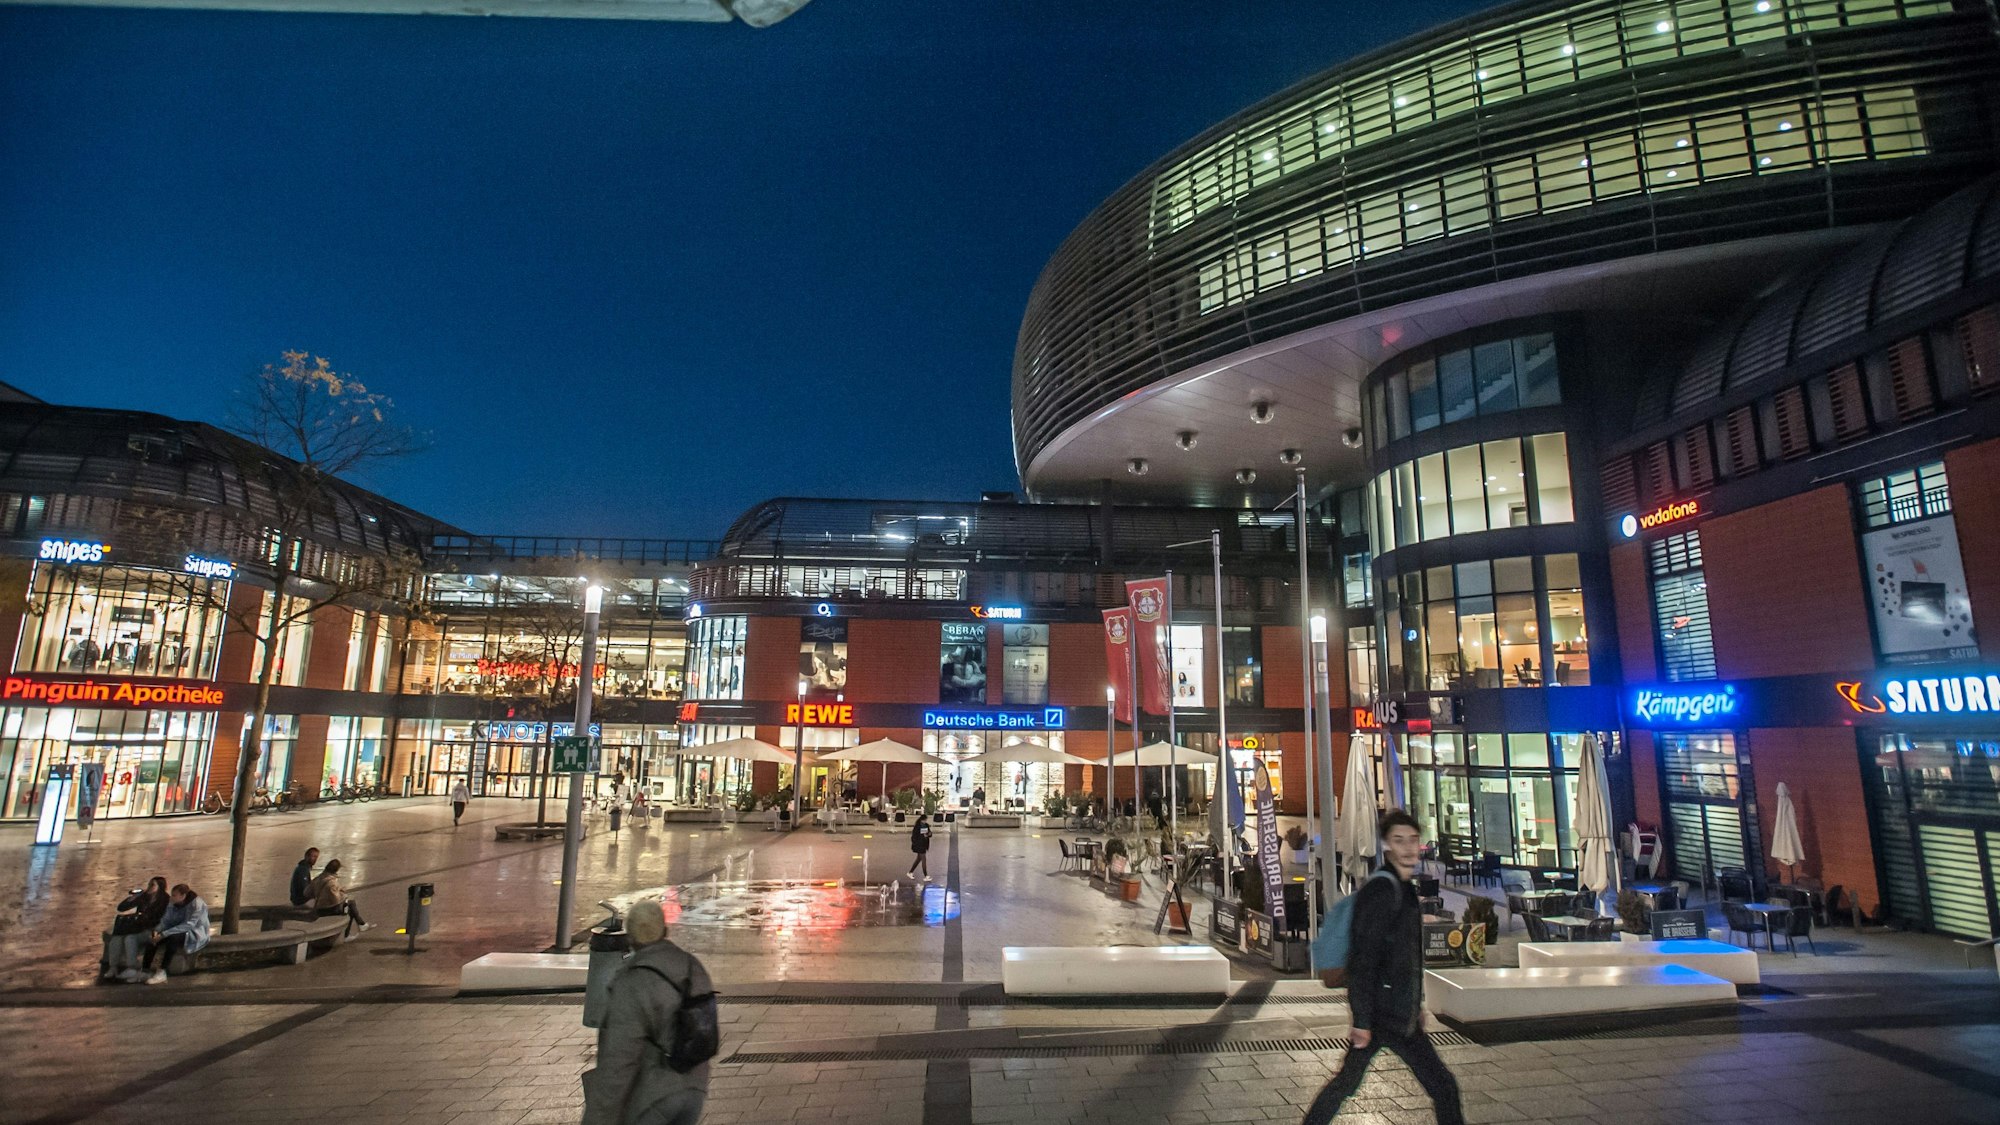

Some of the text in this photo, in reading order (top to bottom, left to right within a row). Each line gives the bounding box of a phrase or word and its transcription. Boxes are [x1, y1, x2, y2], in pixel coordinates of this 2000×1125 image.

[1640, 501, 1698, 529] vodafone
[40, 540, 103, 564] snipes
[987, 606, 1022, 619] SATURN
[4, 678, 224, 706] Pinguin Apotheke
[786, 703, 853, 724] REWE
[1636, 690, 1734, 721] Kämpgen
[925, 712, 1035, 727] Deutsche Bank
